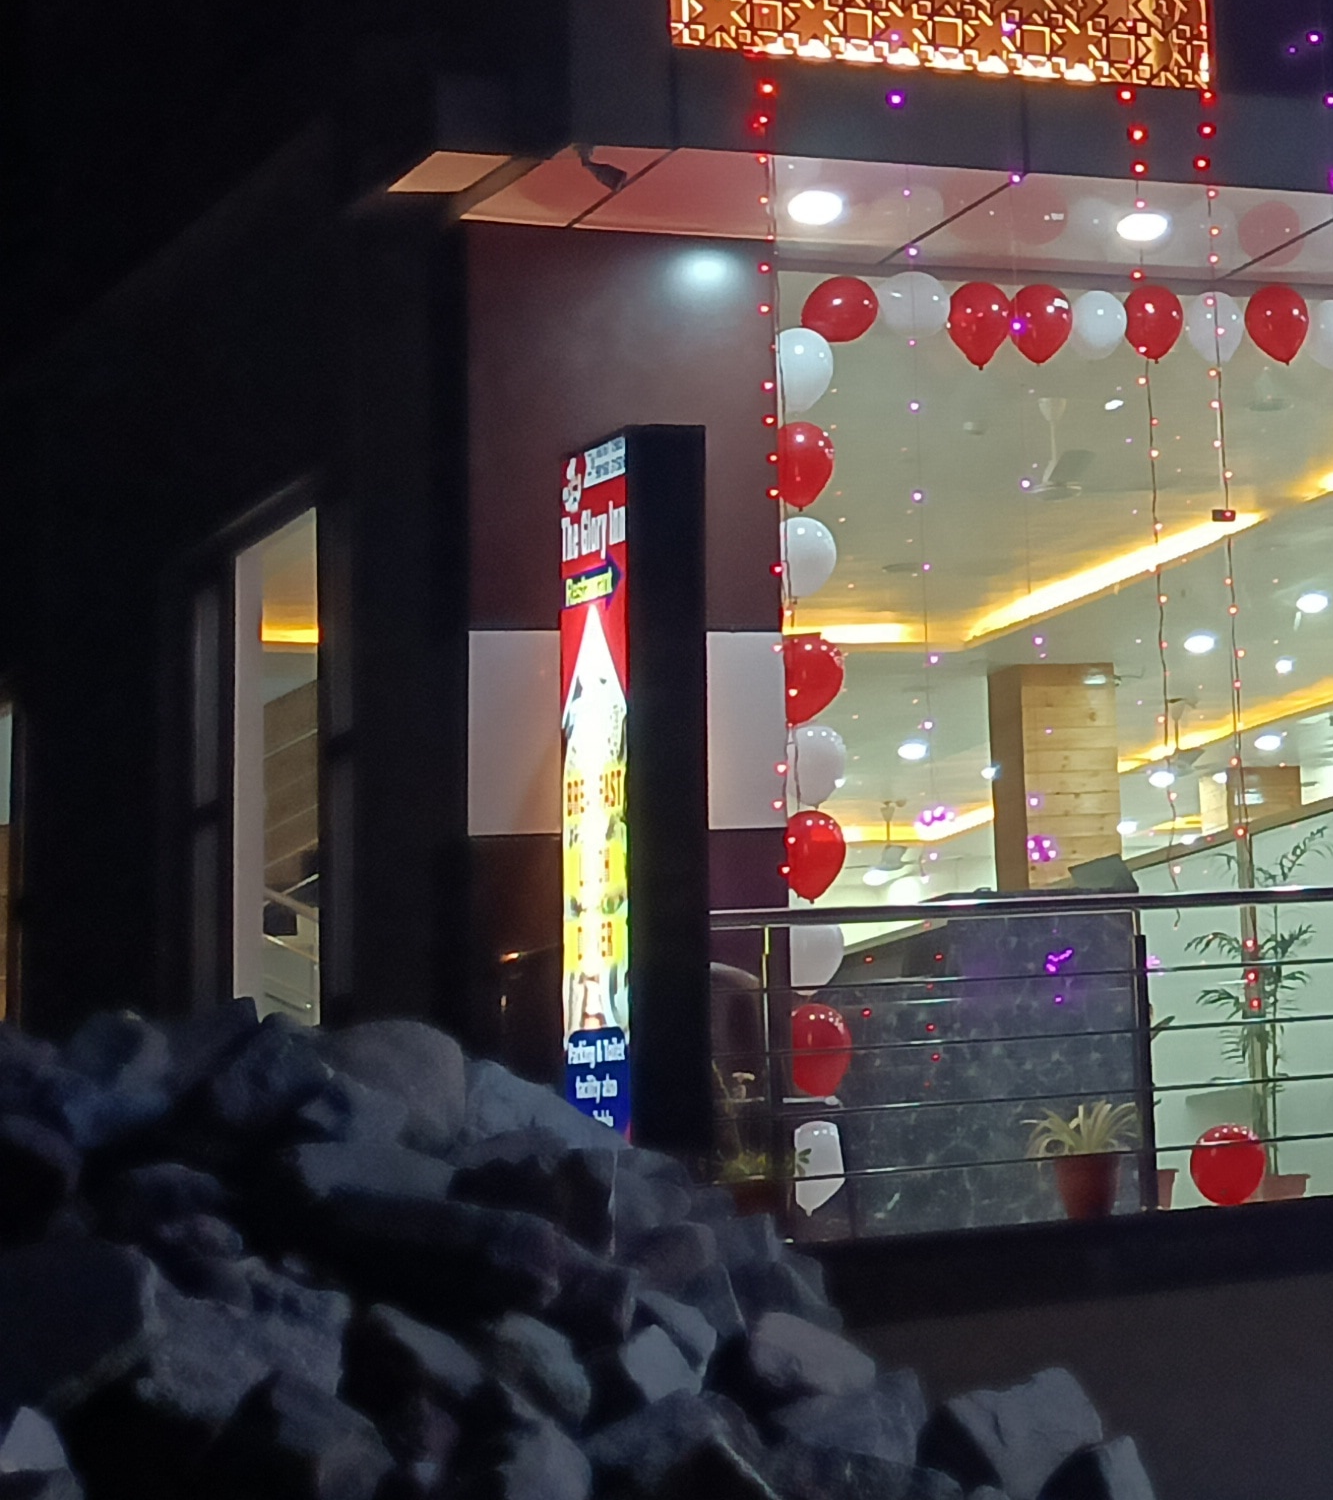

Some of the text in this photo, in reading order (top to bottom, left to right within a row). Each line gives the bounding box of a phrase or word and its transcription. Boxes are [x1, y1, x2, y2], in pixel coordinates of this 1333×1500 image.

[561, 500, 626, 563] The Glory Inn
